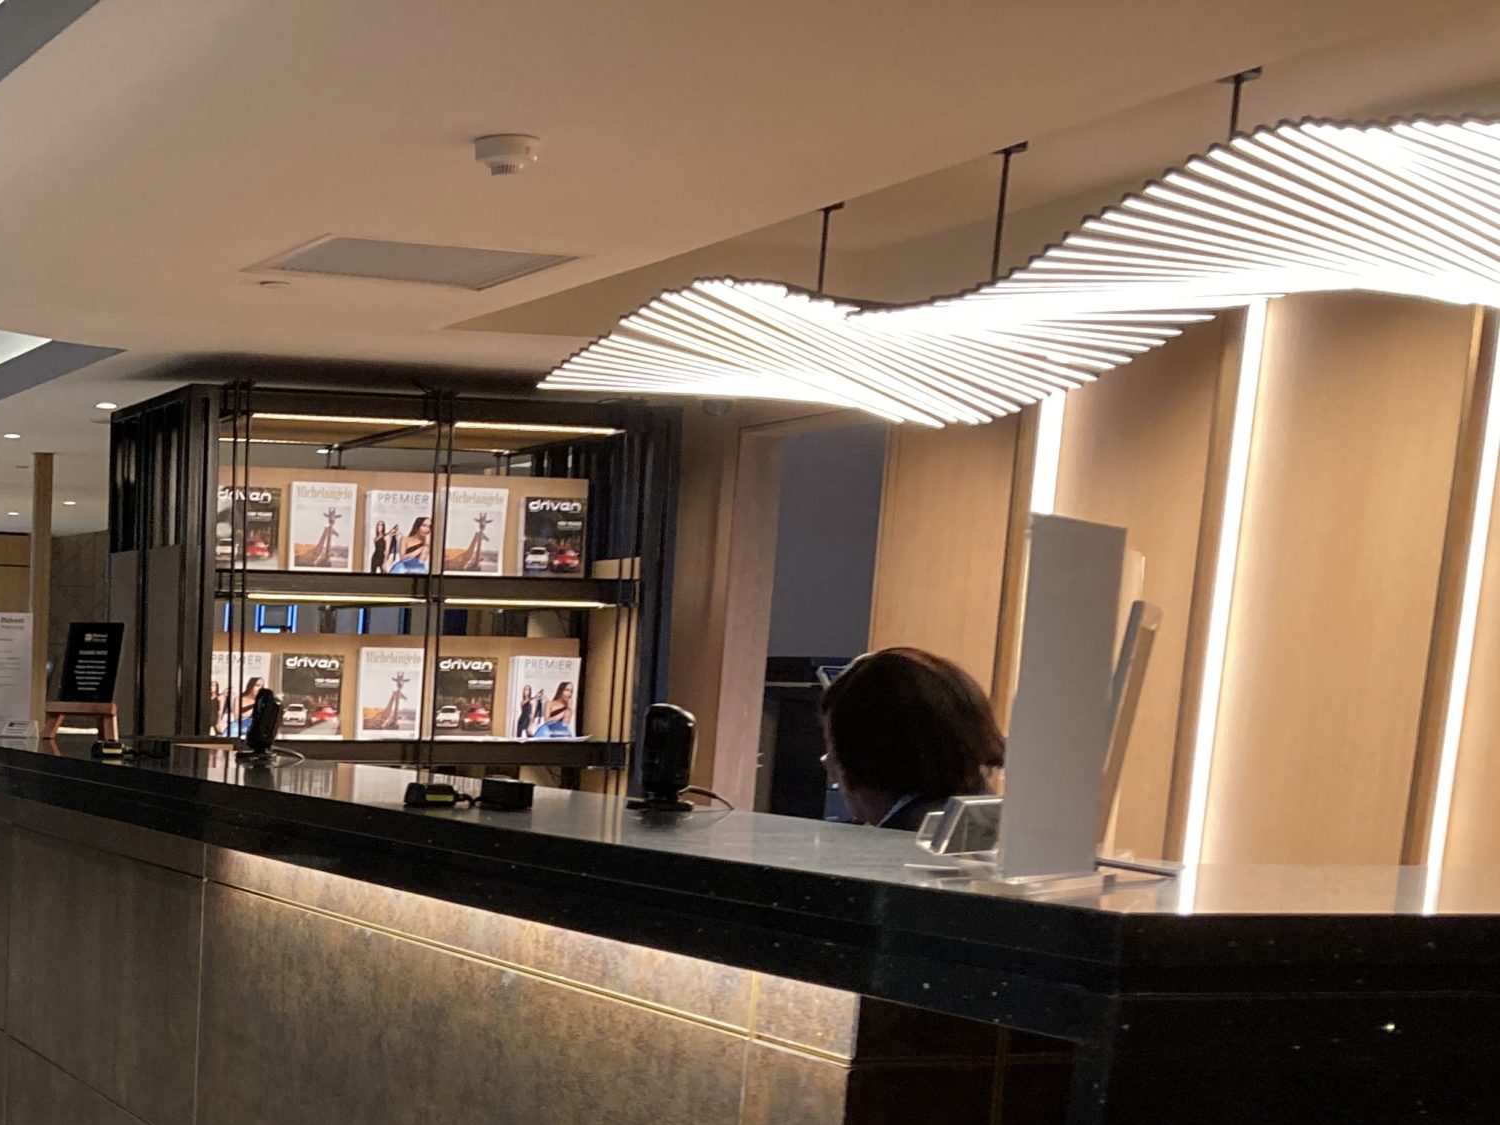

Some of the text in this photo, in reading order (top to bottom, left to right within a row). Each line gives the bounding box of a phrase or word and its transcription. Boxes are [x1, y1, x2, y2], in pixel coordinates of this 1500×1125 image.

[296, 485, 353, 501] Michelangelo
[377, 493, 430, 505] PREMIER
[528, 499, 582, 513] driven
[285, 656, 340, 670] driven
[366, 651, 422, 666] Michelangelo
[439, 658, 493, 671] driven
[525, 658, 573, 671] PREMIER
